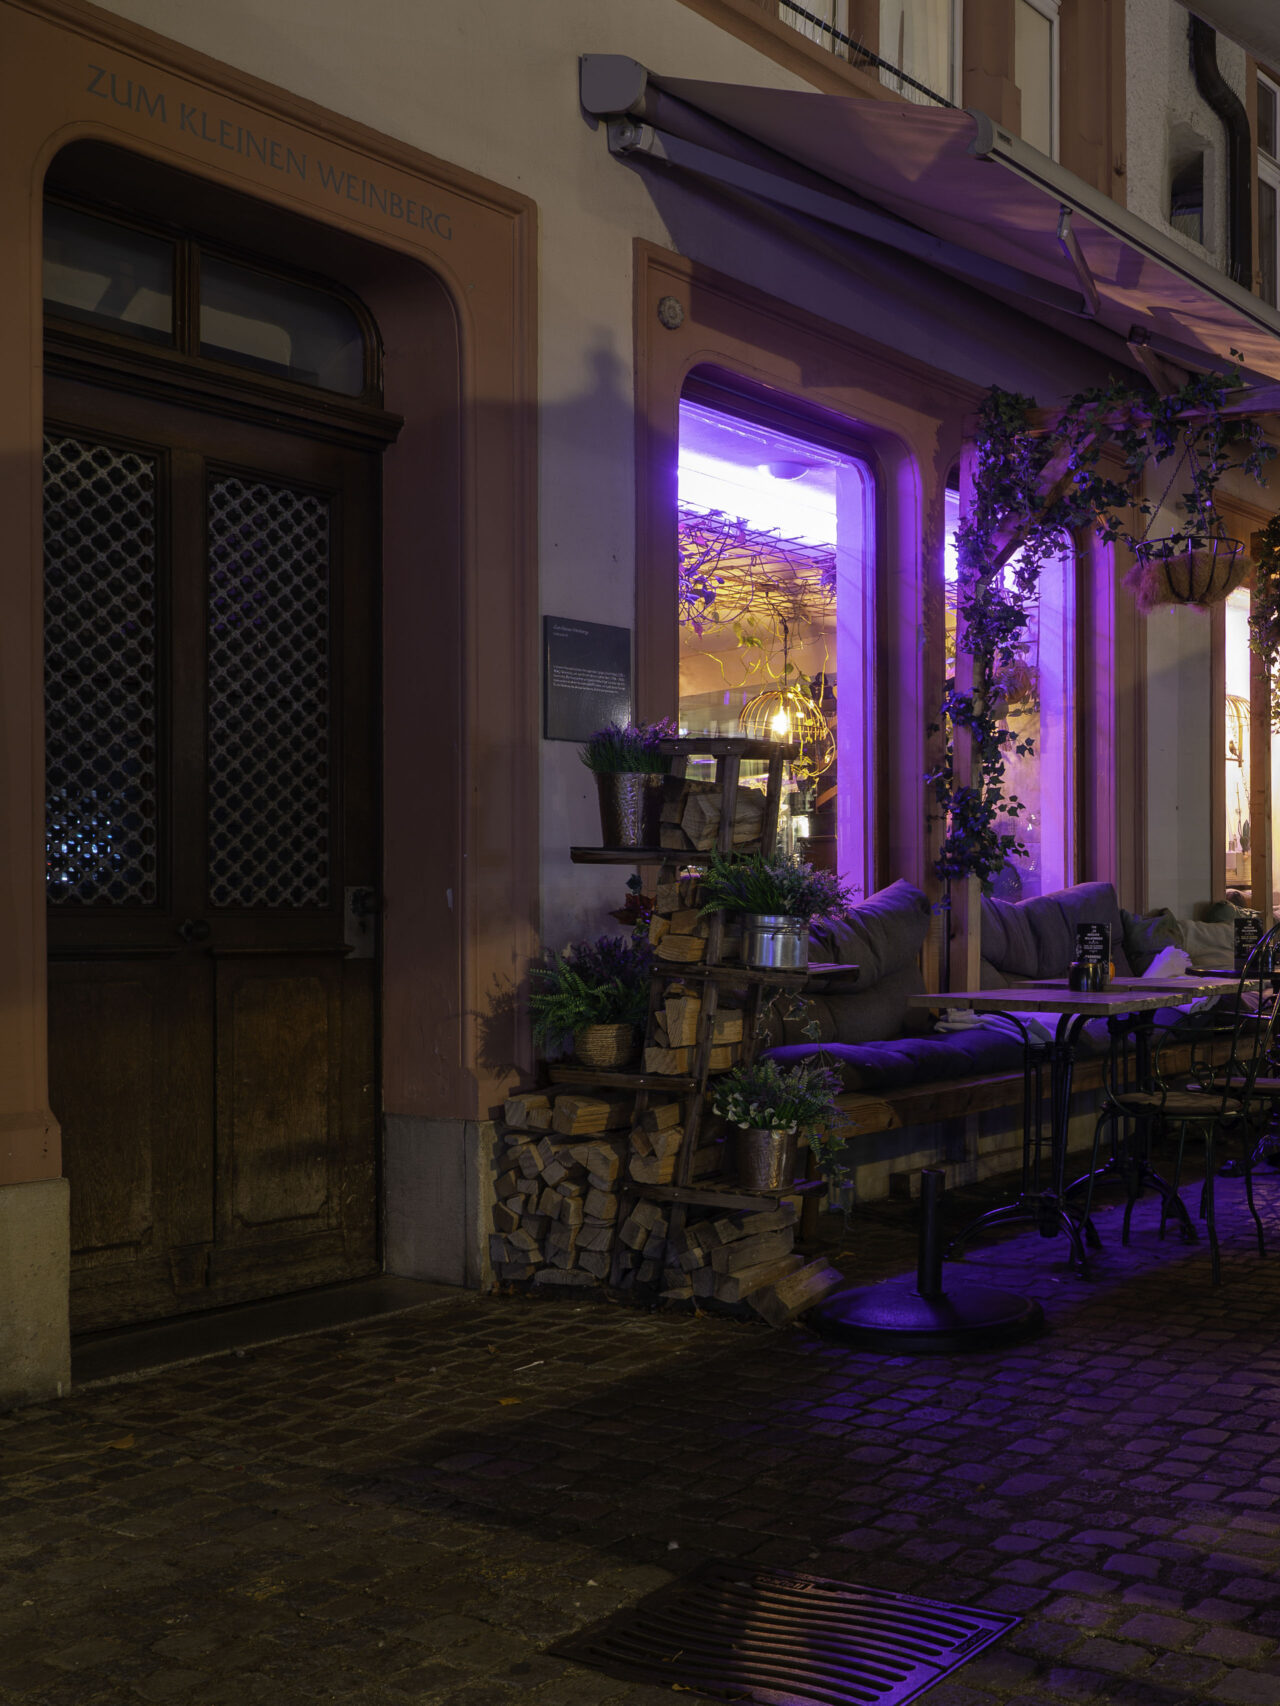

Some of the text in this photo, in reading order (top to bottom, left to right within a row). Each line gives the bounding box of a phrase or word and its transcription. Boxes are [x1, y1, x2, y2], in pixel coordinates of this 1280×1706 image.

[86, 63, 454, 241] ZUM KLEINEN WEINBERG
